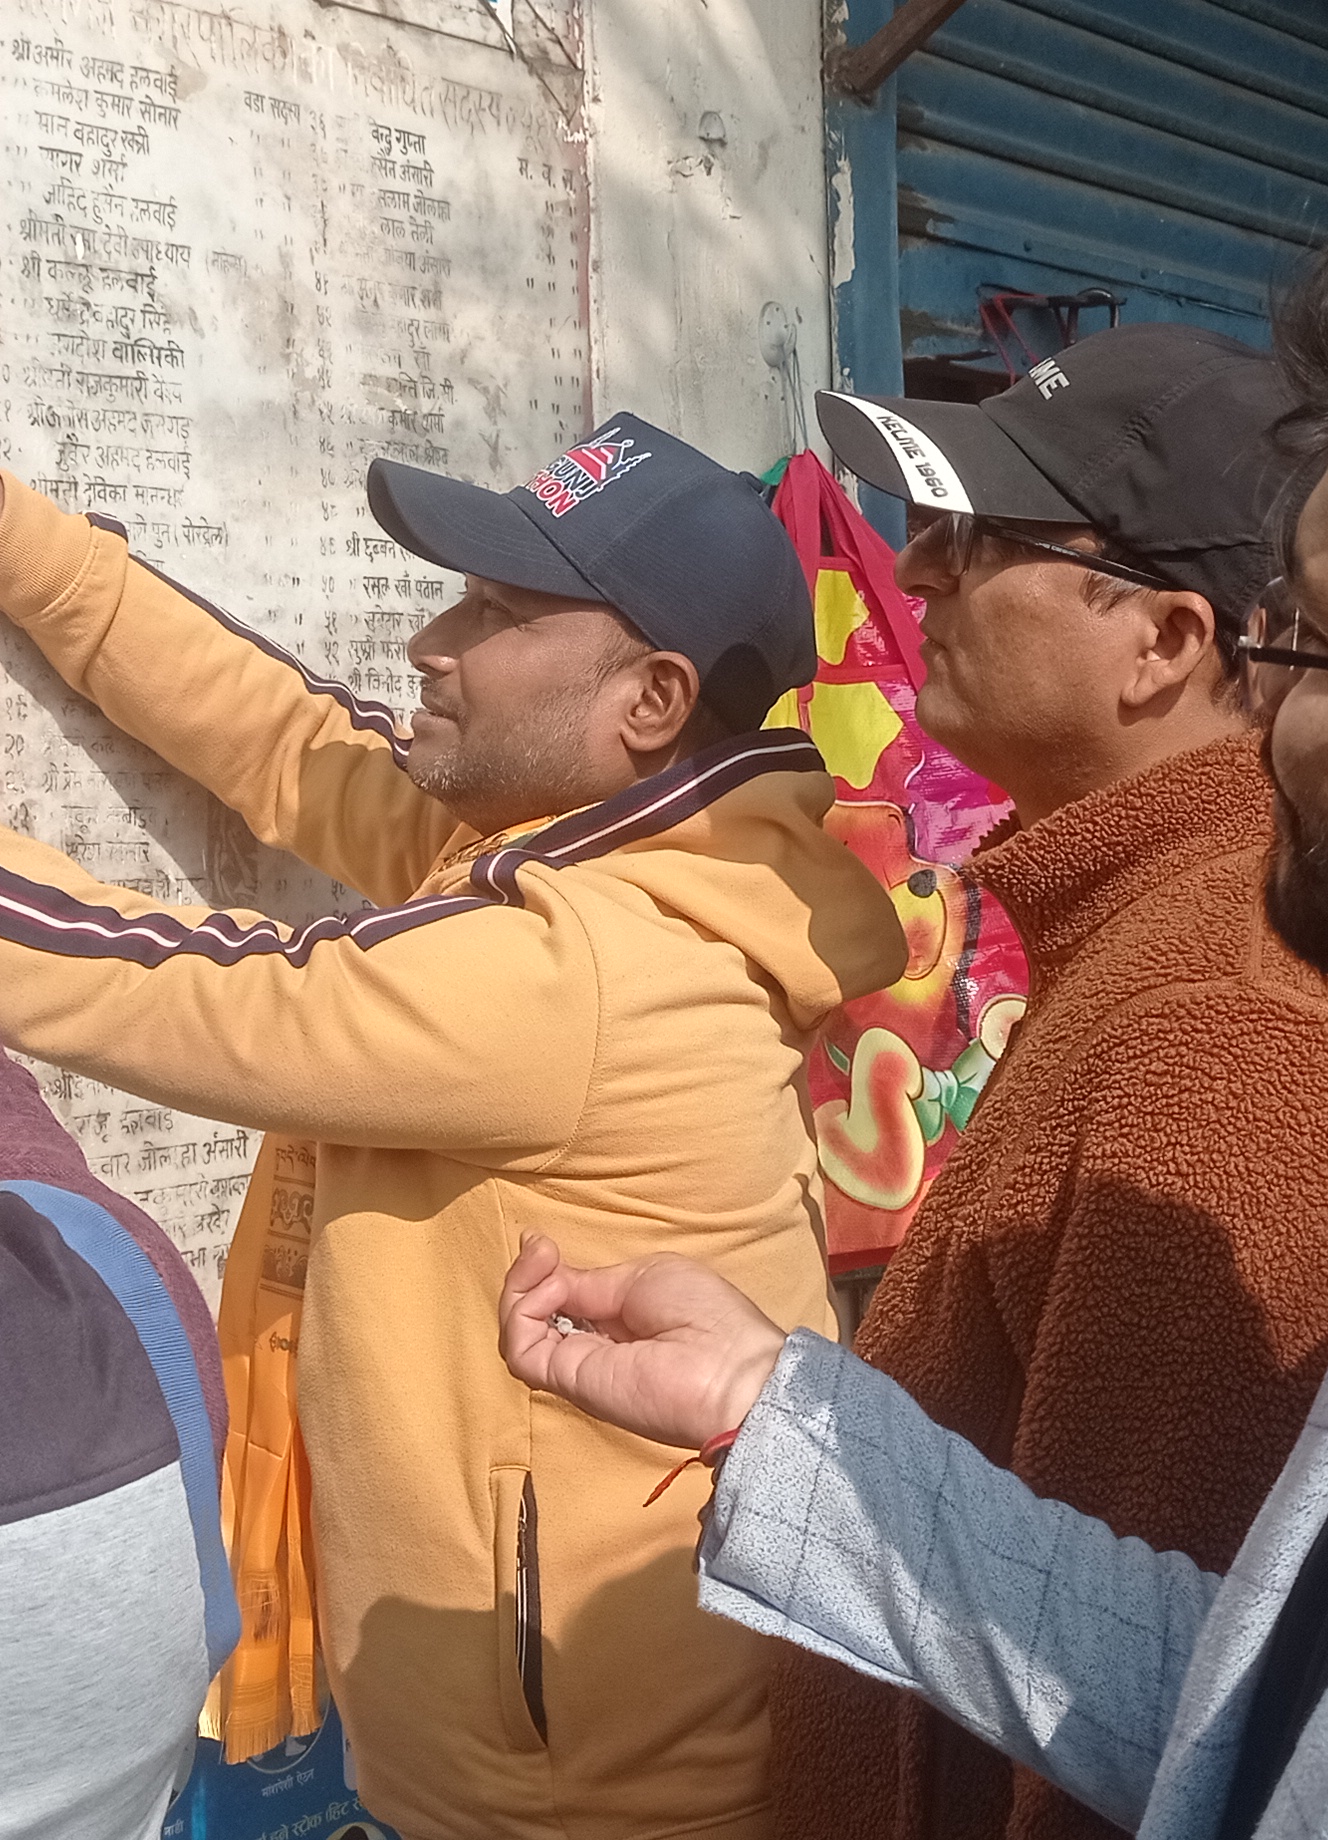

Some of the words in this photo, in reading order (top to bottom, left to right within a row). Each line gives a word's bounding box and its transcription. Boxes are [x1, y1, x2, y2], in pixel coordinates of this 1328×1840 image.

[94, 90, 134, 119] कुमार
[876, 415, 927, 460] KELME
[914, 462, 949, 499] 1960
